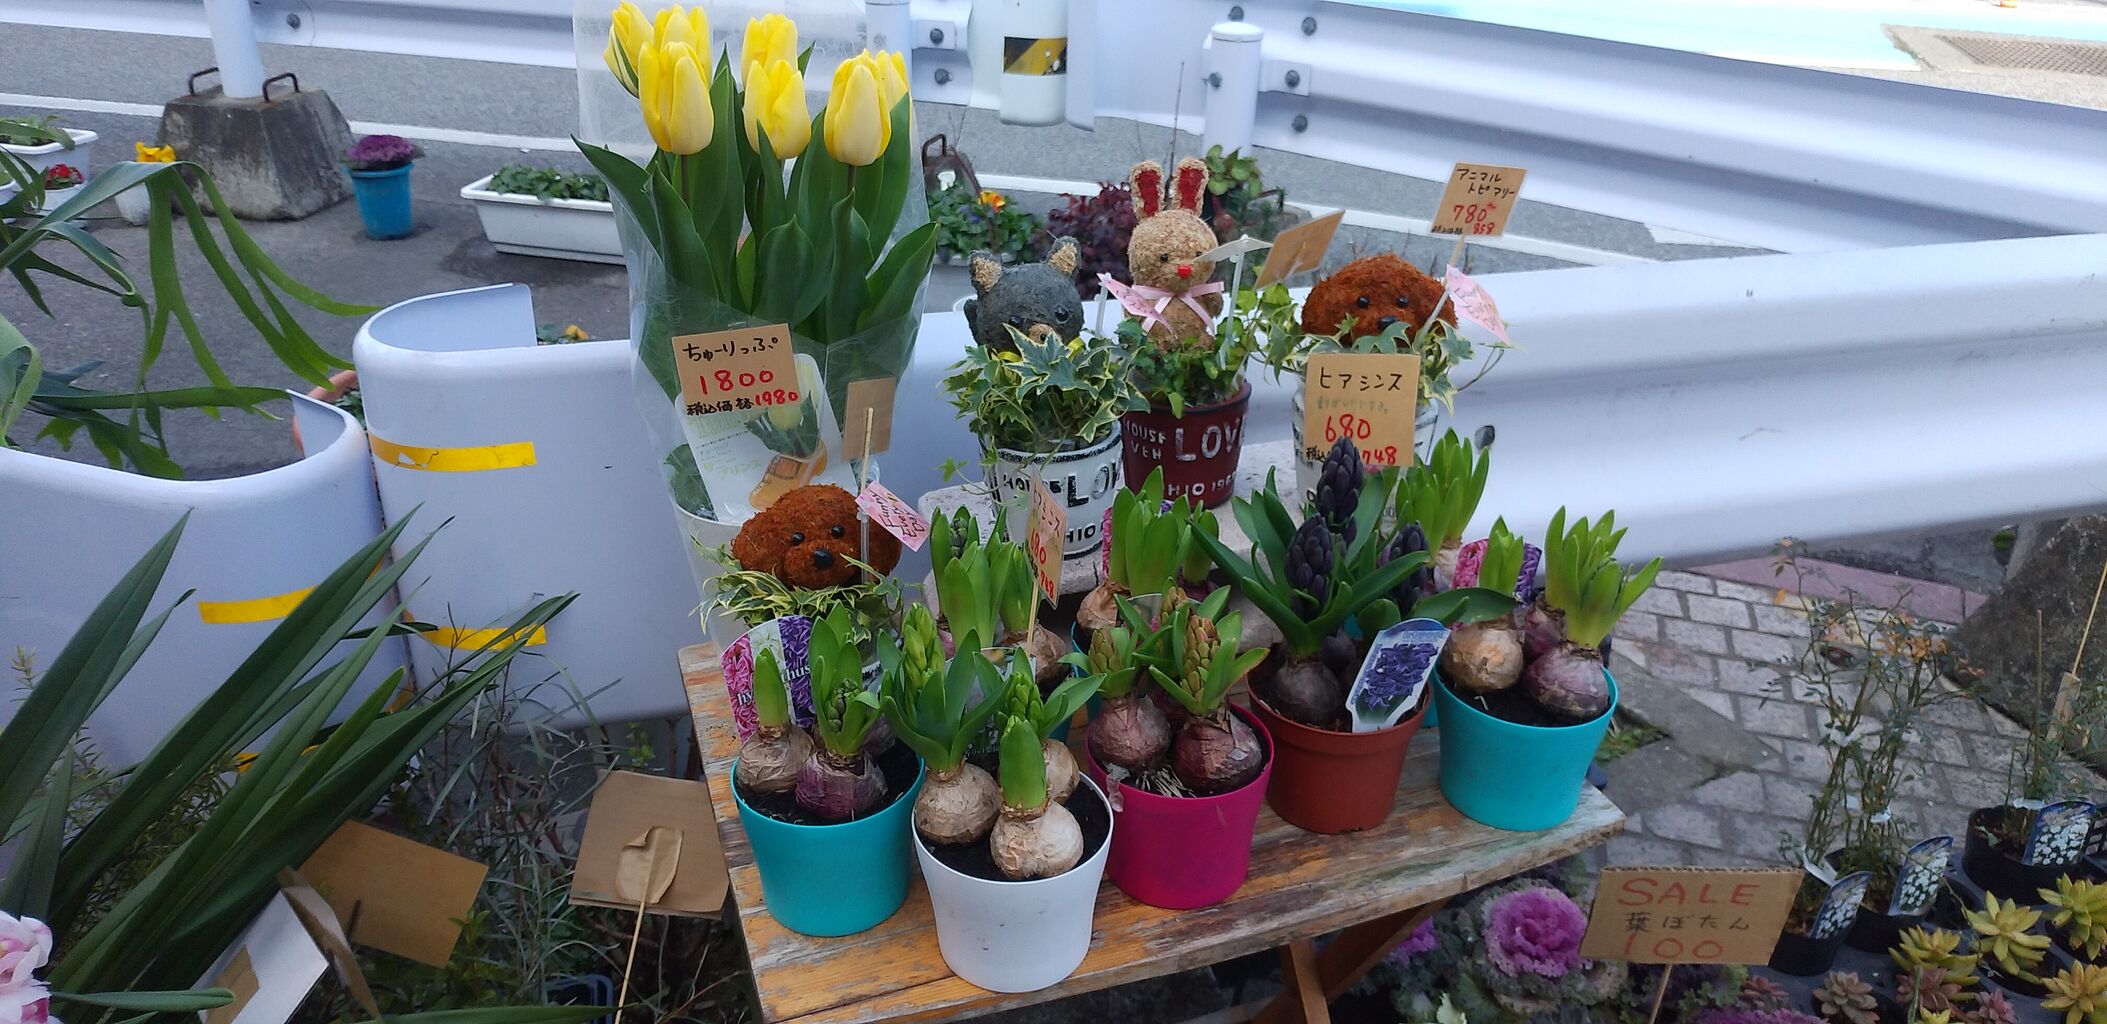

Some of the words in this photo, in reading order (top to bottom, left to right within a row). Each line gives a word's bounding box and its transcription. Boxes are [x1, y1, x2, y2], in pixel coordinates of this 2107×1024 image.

[1456, 168, 1502, 182] アニマル
[1453, 204, 1487, 224] 780
[683, 337, 779, 362] ちゅーりっぷ
[699, 369, 775, 396] 1800
[1319, 366, 1403, 392] ヒアシンス
[754, 389, 799, 407] 1980
[1324, 413, 1371, 443] 680
[1361, 445, 1398, 465] 748
[1029, 528, 1047, 565] 680
[1617, 877, 1761, 906] SALE
[1624, 911, 1749, 932] 葉ぼたん
[1624, 930, 1723, 959] 100
